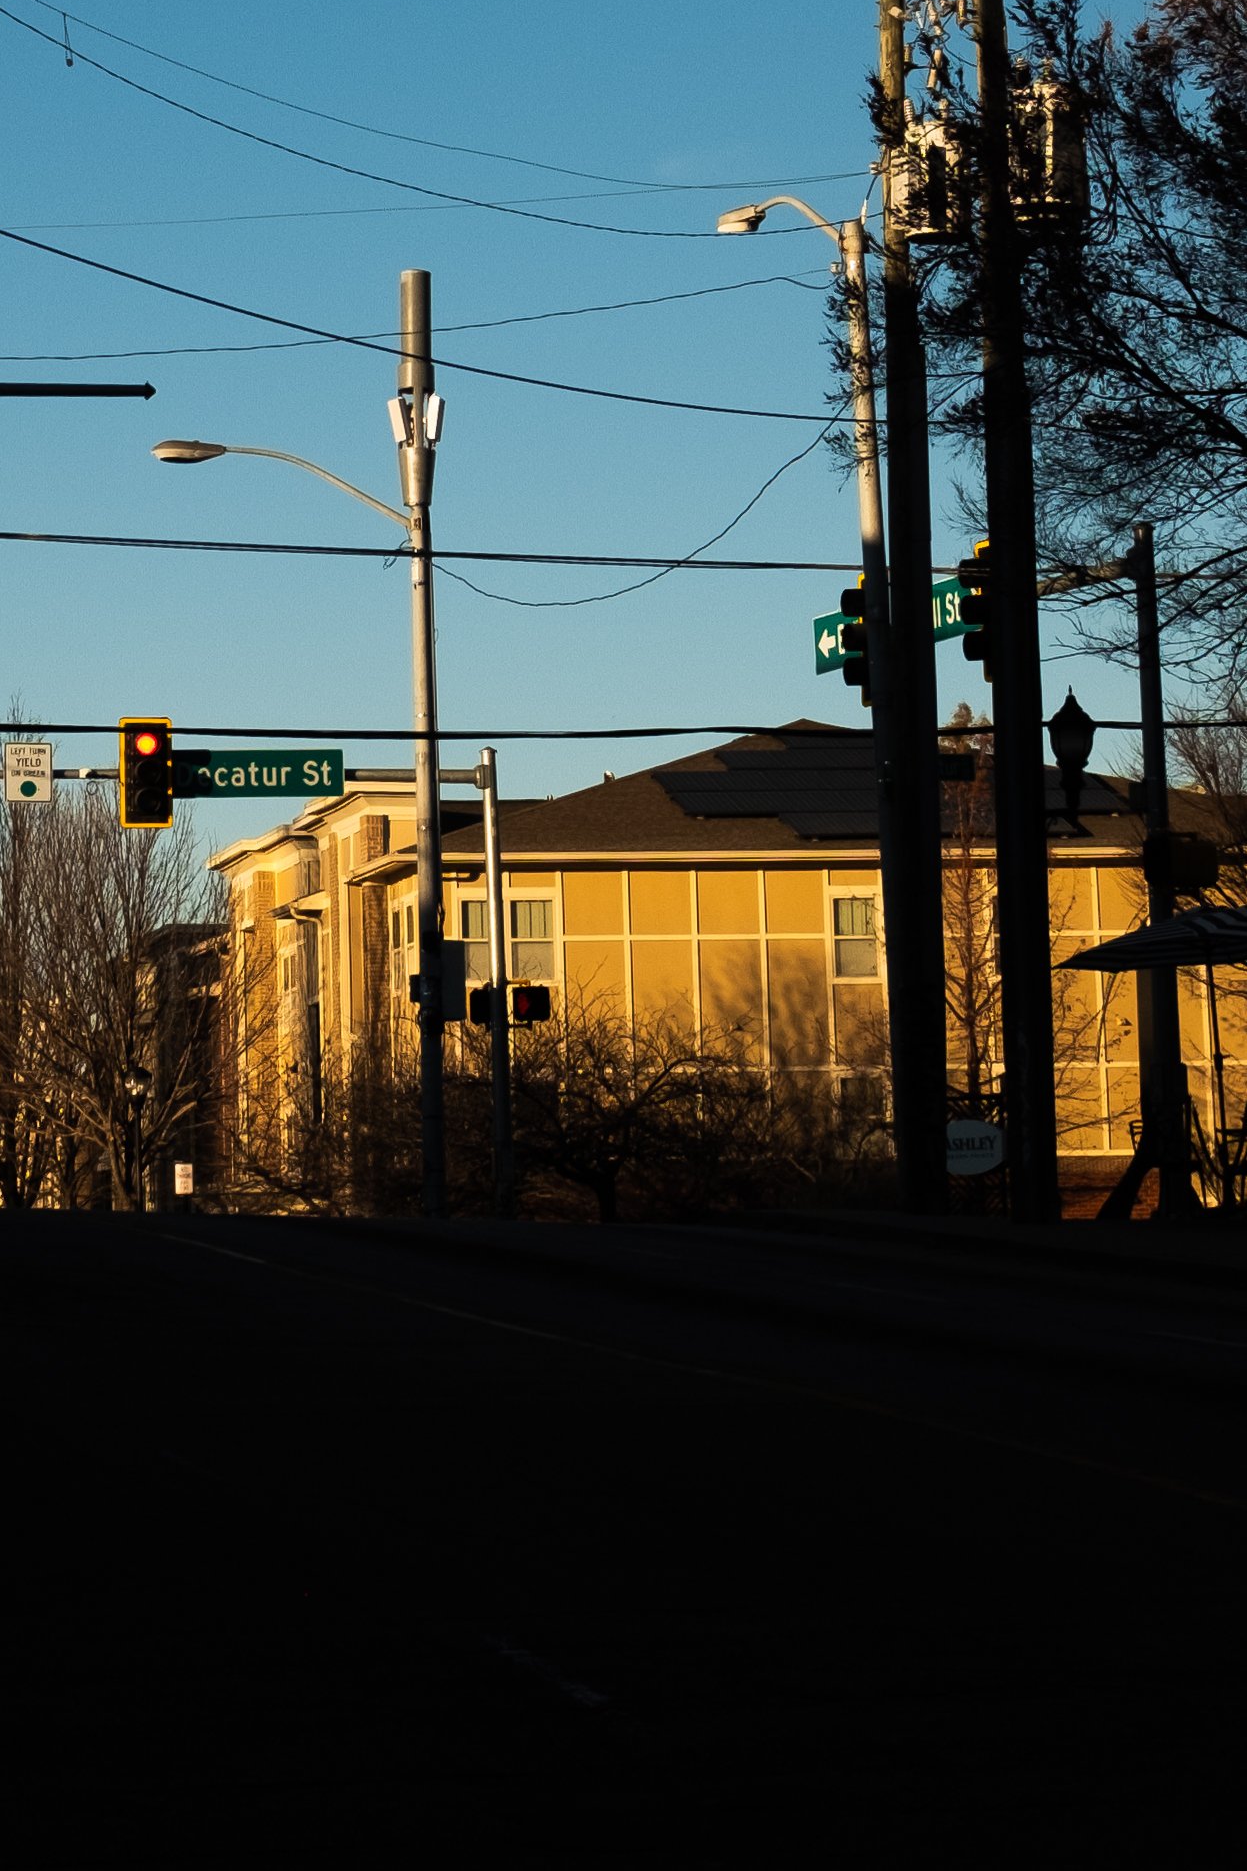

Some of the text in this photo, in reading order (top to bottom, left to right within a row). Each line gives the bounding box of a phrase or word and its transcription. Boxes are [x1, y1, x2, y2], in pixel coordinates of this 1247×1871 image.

[945, 591, 961, 624] St
[16, 758, 41, 767] YIELD
[302, 760, 332, 787] St
